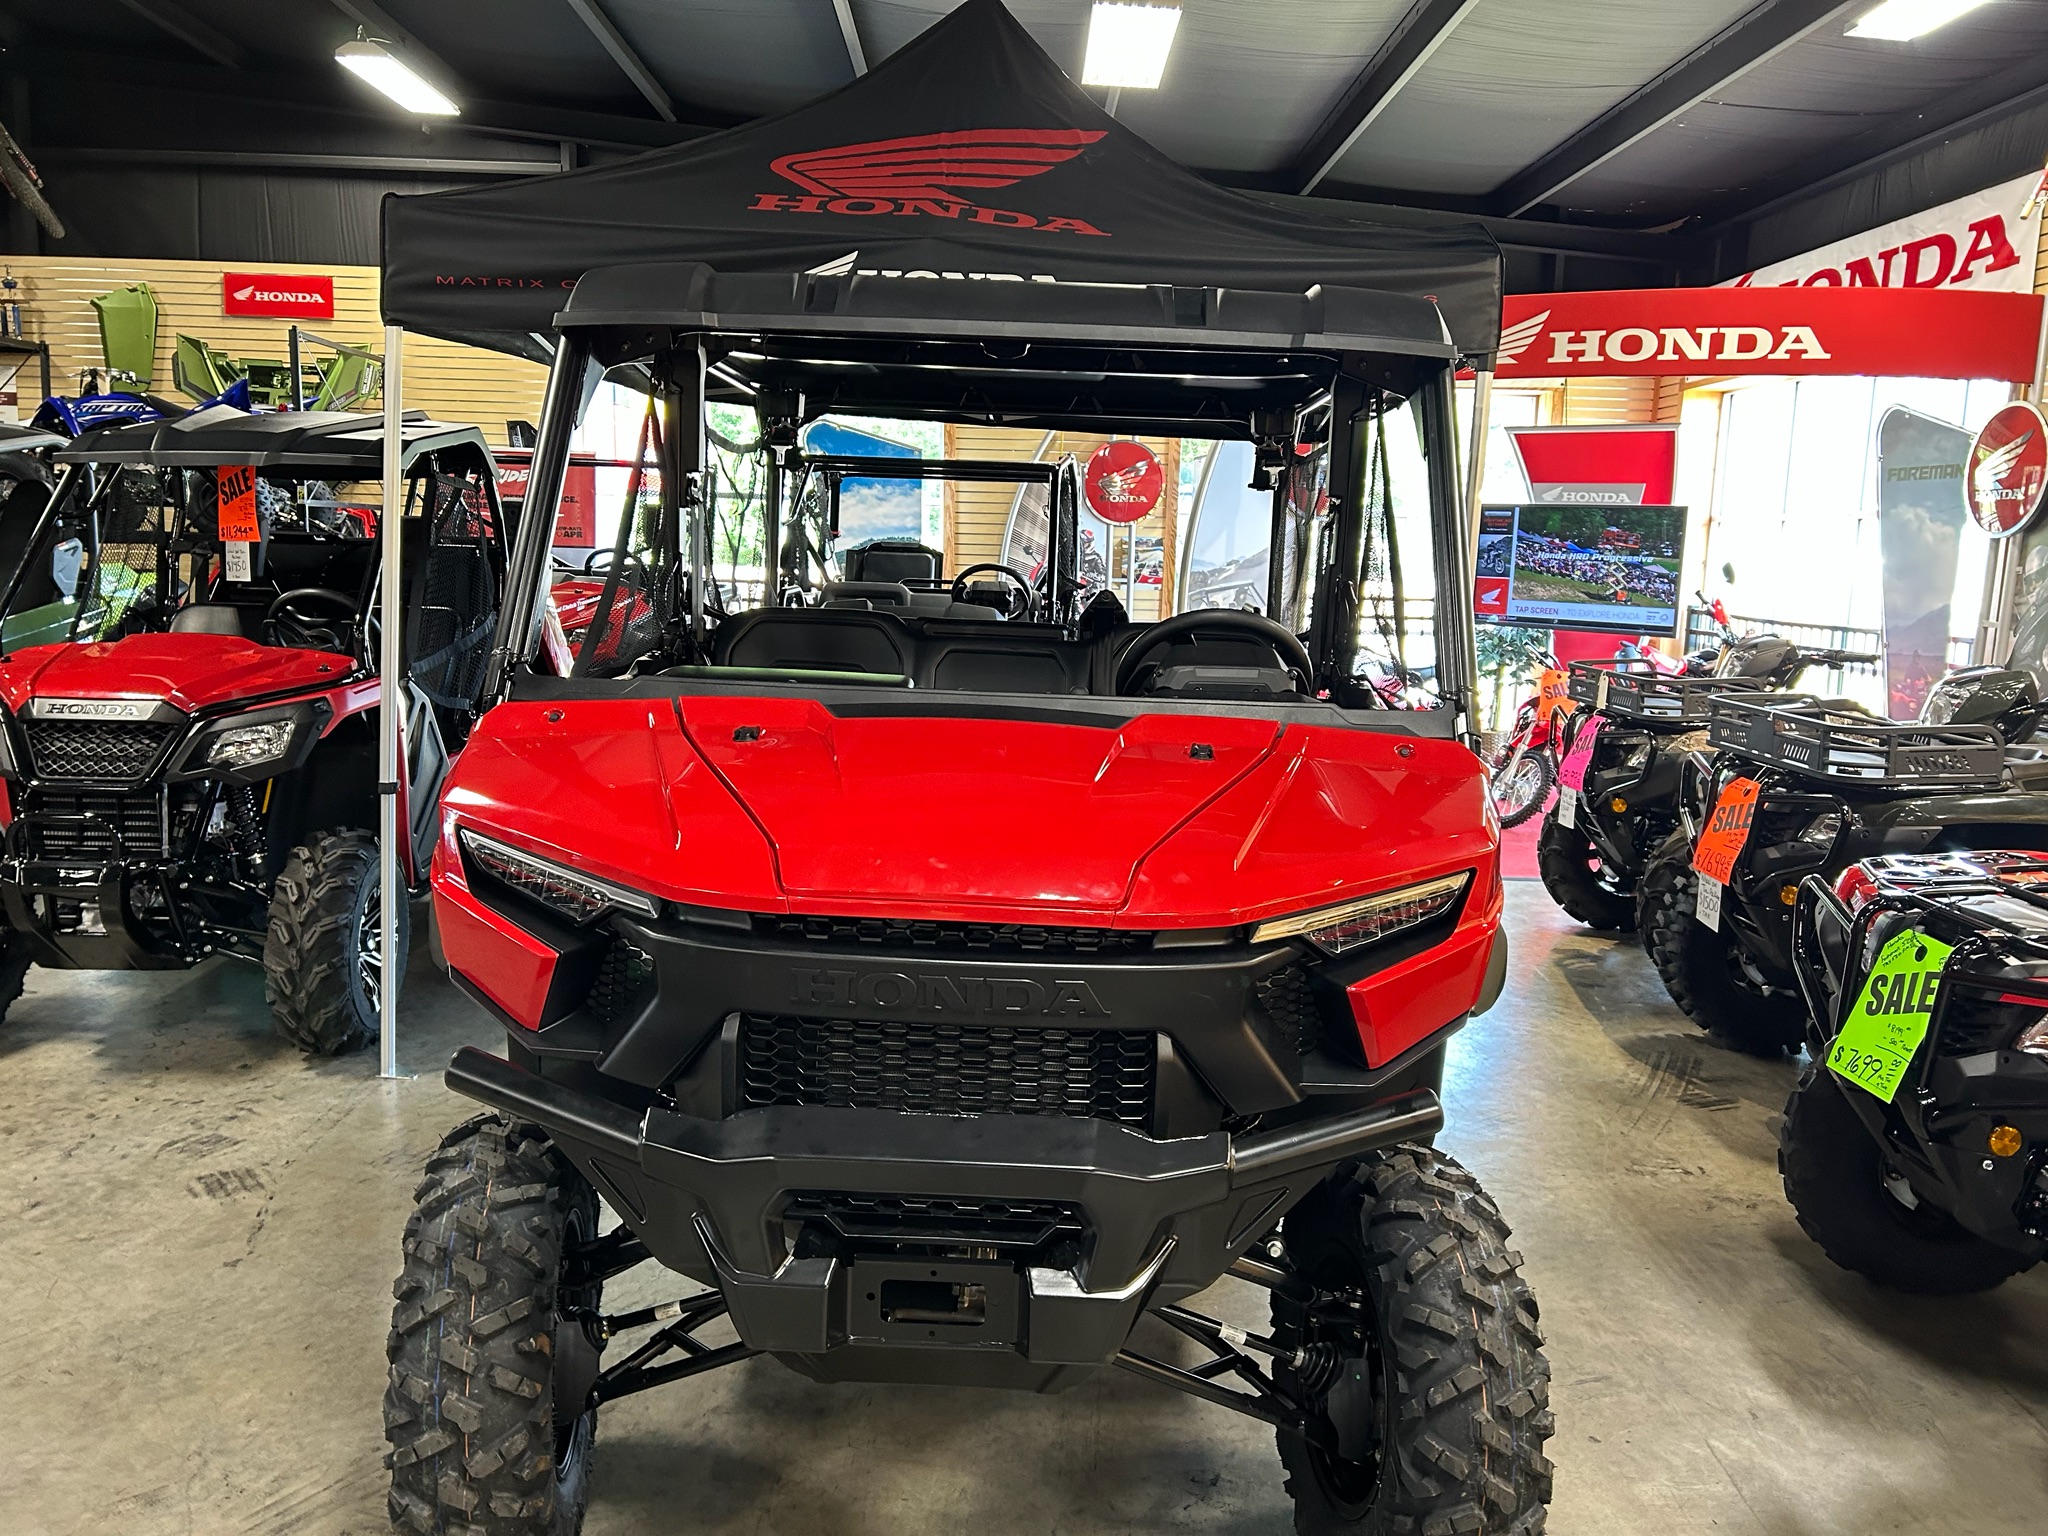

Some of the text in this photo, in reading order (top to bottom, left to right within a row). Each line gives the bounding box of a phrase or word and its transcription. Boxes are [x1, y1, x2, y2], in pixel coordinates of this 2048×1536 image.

[747, 194, 1112, 236] HONDA
[1779, 214, 2021, 288] NDA
[436, 276, 576, 288] MATRIX C
[254, 291, 325, 303] HONDA
[1548, 326, 1831, 363] HONDA
[1887, 464, 1964, 481] FOREMAN
[220, 467, 252, 506] SALE
[1561, 492, 1631, 503] HONDA
[1538, 551, 1566, 560] Honda
[1592, 553, 1654, 564] Progressive
[1515, 605, 1530, 613] TAP
[1530, 606, 1559, 615] SCREEN
[1543, 681, 1569, 700] SAL
[45, 704, 140, 716] HONDA
[1572, 733, 1594, 756] SAL
[1712, 803, 1754, 833] SALE
[790, 967, 1111, 1016] HONDA
[1866, 972, 1940, 1017] SALE
